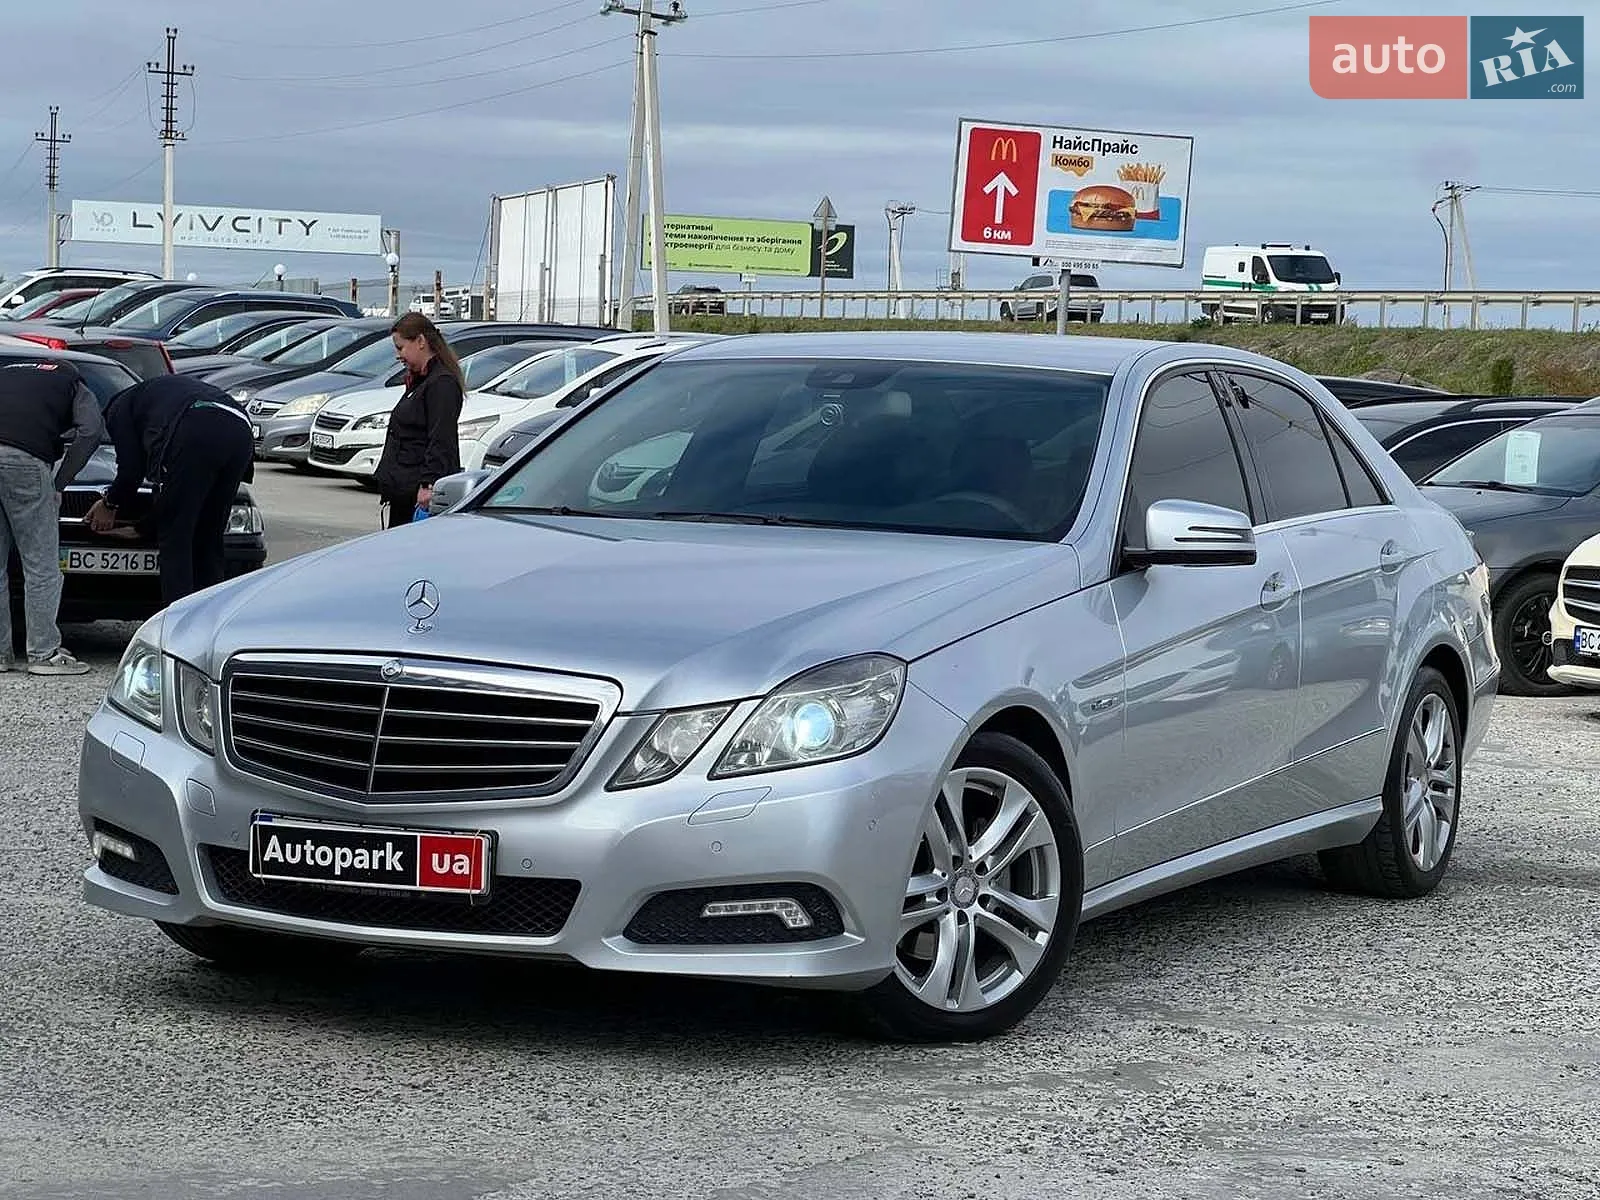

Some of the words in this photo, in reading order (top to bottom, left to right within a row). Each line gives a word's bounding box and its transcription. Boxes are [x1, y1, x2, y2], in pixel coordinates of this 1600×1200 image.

[1052, 135, 1139, 156] НайсПрайс
[1055, 155, 1090, 168] Комбо
[664, 223, 713, 231] тернативні
[69, 551, 95, 569] BC
[100, 552, 139, 570] 5216
[263, 834, 404, 876] Autopark
[431, 851, 470, 875] ua
